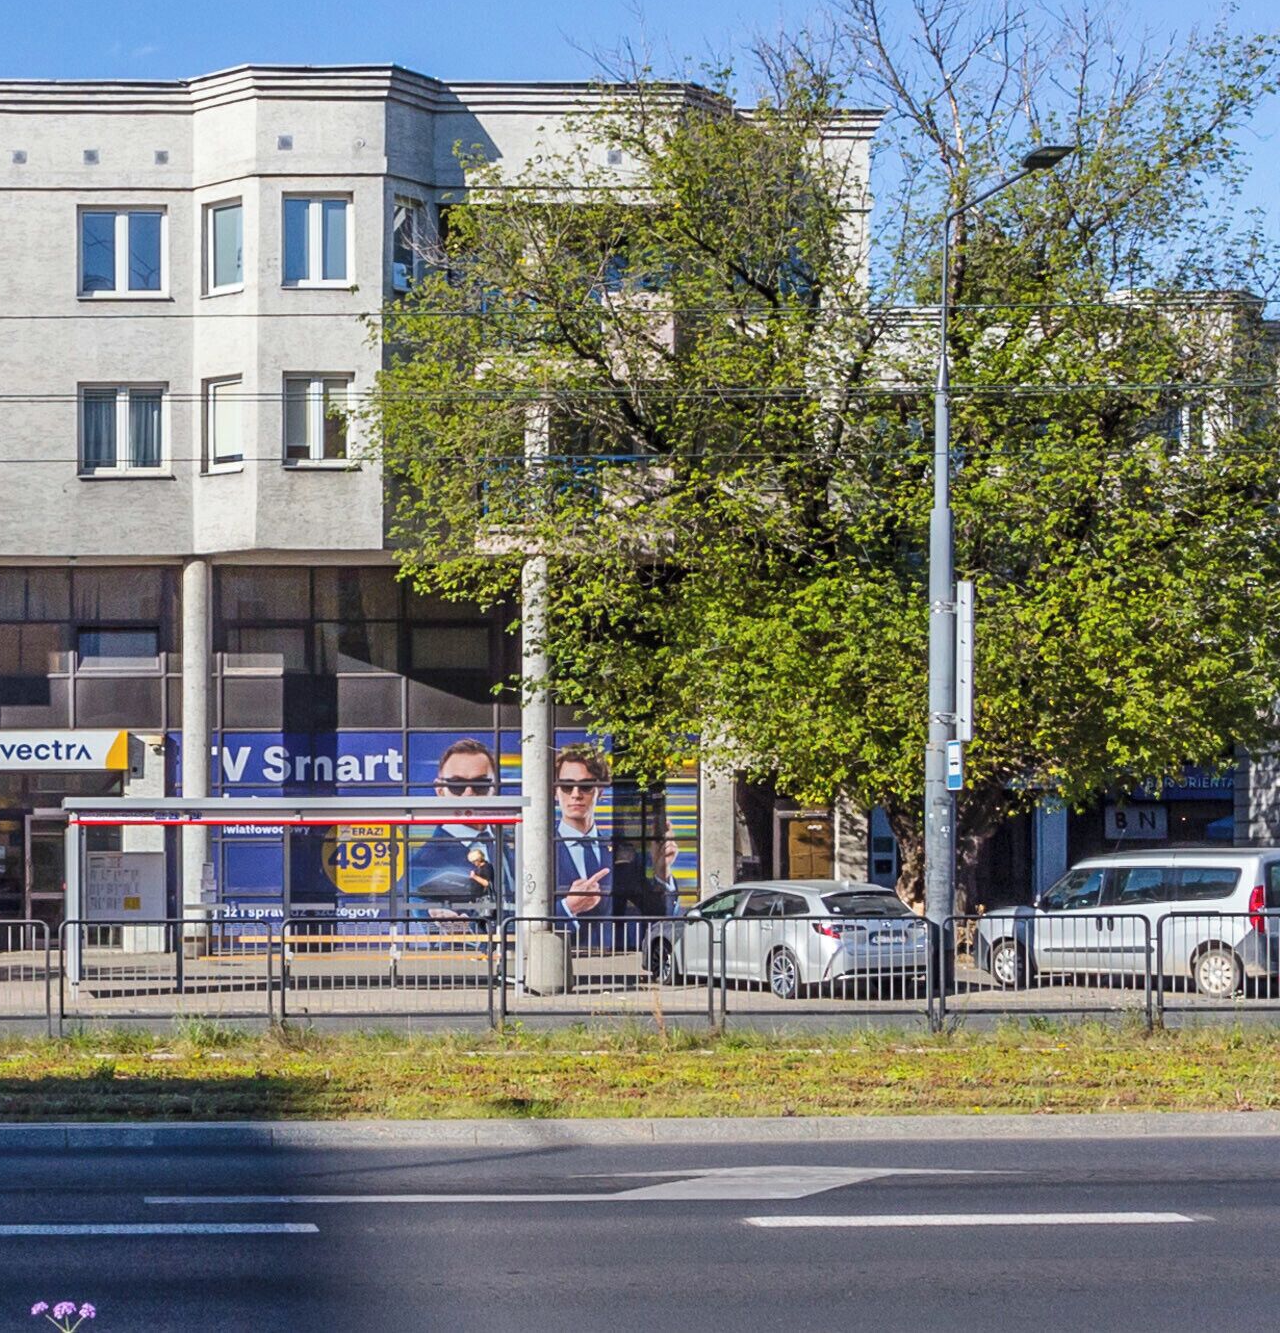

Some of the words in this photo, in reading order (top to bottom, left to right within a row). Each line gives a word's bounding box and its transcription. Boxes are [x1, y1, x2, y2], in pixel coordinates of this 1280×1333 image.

[0, 739, 92, 761] vectra
[262, 745, 404, 782] Smart
[344, 826, 384, 837] ERAZ!
[328, 842, 373, 870] 49
